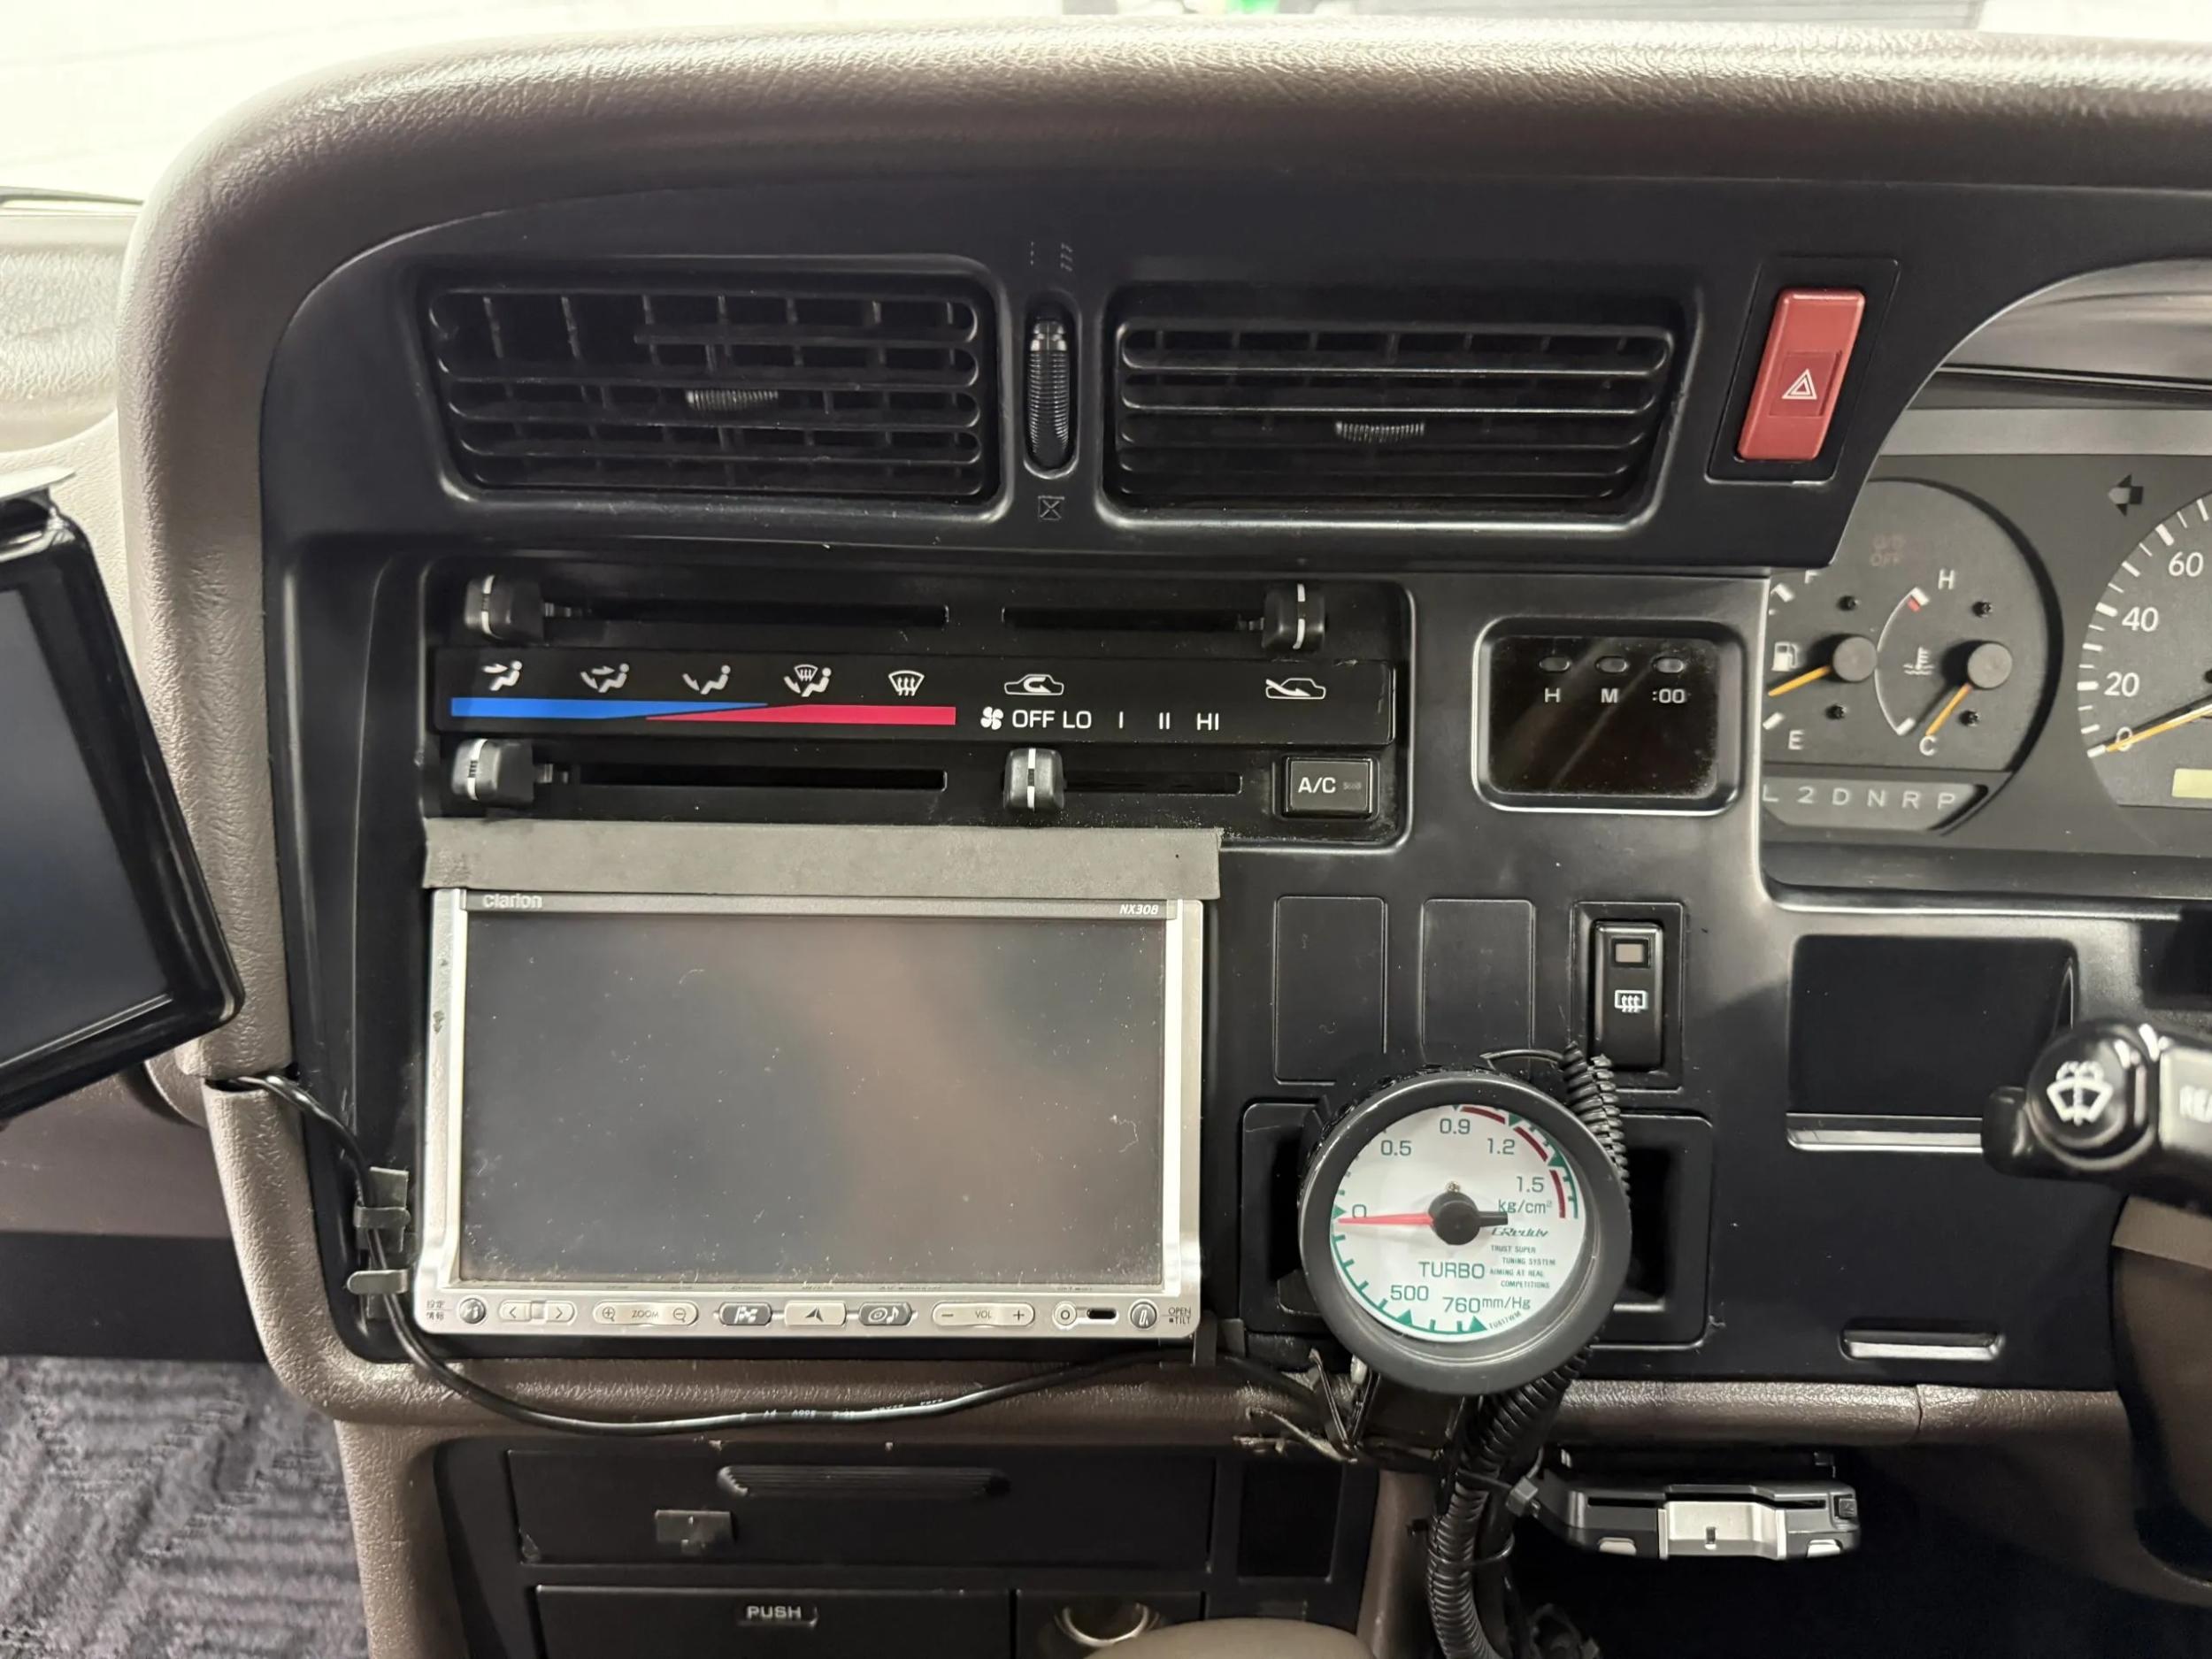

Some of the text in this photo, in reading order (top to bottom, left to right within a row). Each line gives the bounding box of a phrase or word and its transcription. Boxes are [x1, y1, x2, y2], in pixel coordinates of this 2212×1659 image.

[2168, 551, 2204, 577] 60
[1938, 568, 1955, 590] H
[2122, 606, 2159, 632] 40
[2104, 671, 2139, 697] 20
[1544, 687, 1561, 703] H
[1601, 688, 1618, 703] M
[1652, 688, 1686, 703] :00
[1011, 710, 1055, 728] OFF
[1063, 711, 1092, 729] LO
[1196, 713, 1220, 731] HI
[1789, 731, 1804, 750] E
[1919, 735, 1938, 756] C
[1297, 776, 1336, 794] A/C
[1762, 784, 1955, 810] L 2 D N R P
[482, 893, 543, 909] clarion
[1119, 903, 1159, 916] NX308
[1439, 1118, 1471, 1135] 0.9
[1380, 1140, 1412, 1156] 0.5
[1486, 1138, 1516, 1156] 1.2
[1516, 1176, 1545, 1194] 1.5
[1352, 1203, 1367, 1218] 0
[1491, 1244, 1537, 1255] TRUST SUPER
[1502, 1256, 1556, 1266] TUNING SYSTEM
[1418, 1261, 1486, 1280] TURBO
[1390, 1285, 1430, 1302] 500
[631, 1309, 659, 1319] ZOOM
[975, 1310, 992, 1319] VOL
[1168, 1307, 1191, 1317] OPEN
[746, 1605, 802, 1619] PUSH
